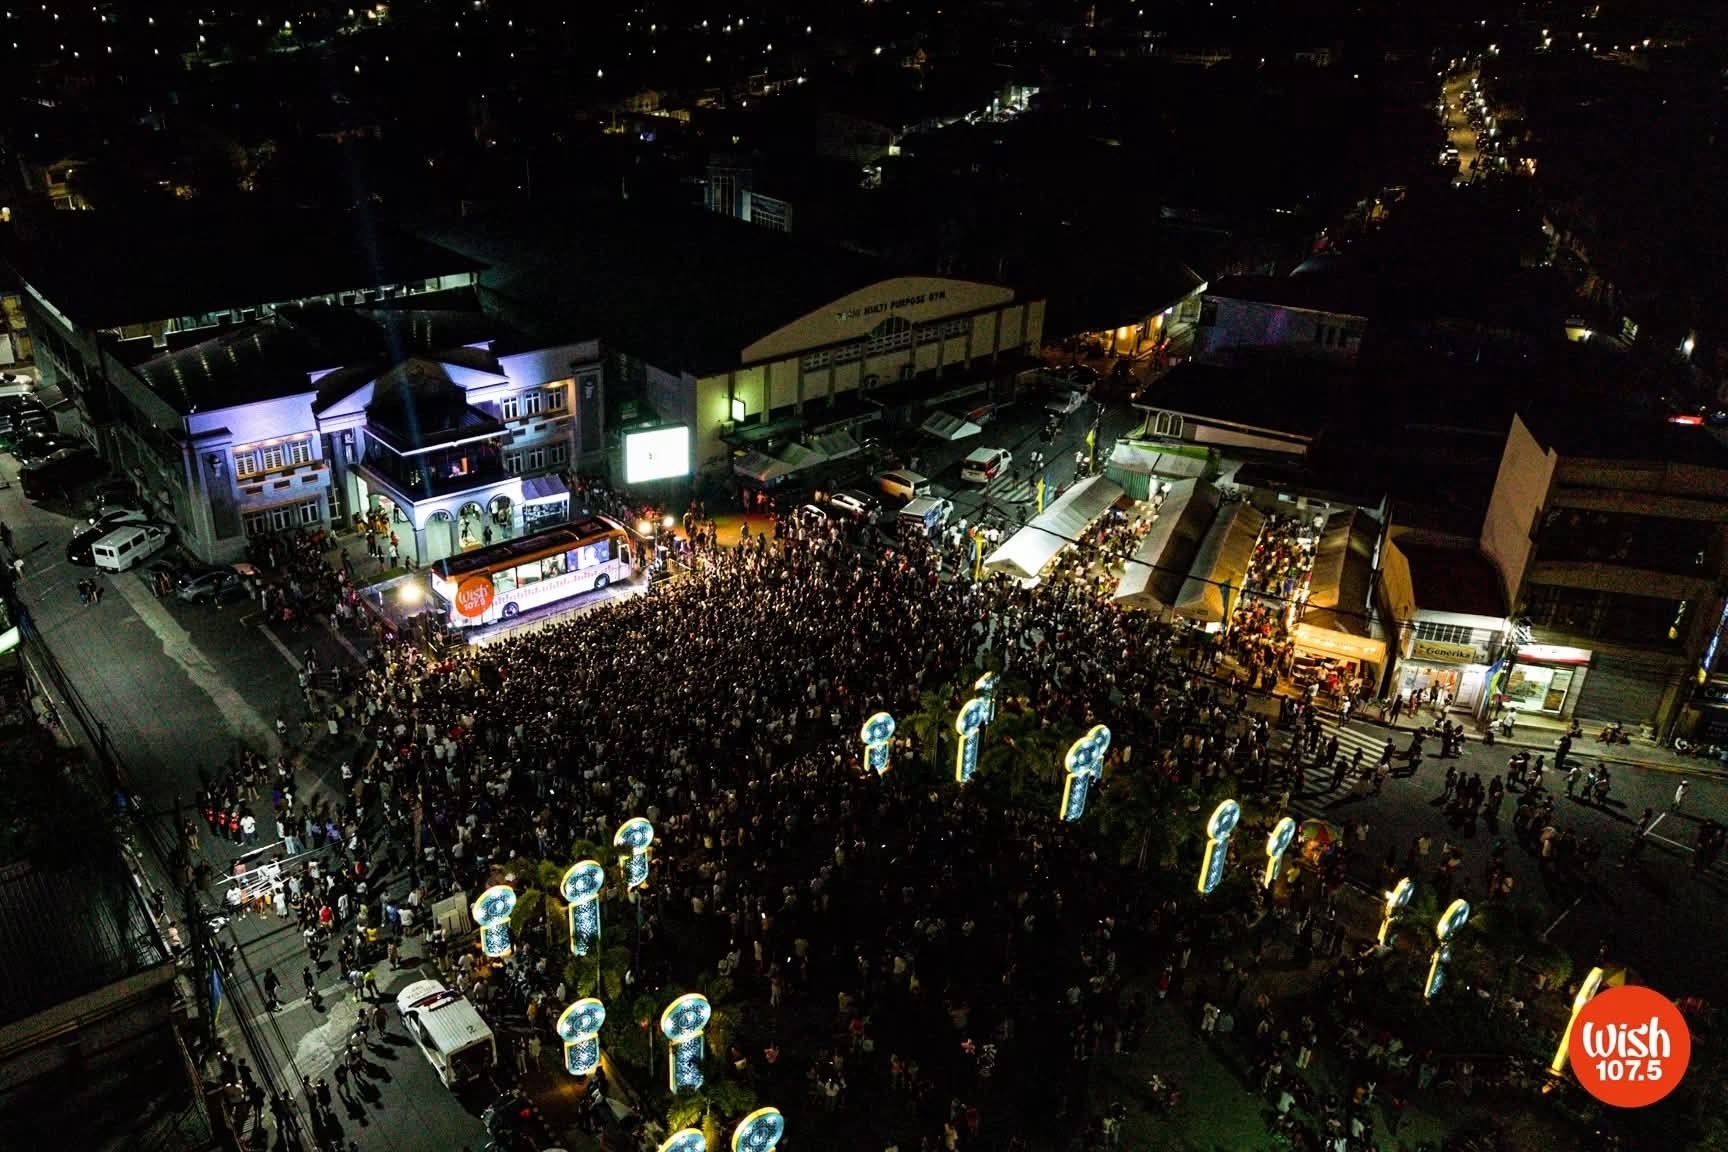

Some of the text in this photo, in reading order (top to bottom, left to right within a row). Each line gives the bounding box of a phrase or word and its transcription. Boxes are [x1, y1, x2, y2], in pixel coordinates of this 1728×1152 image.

[864, 303, 887, 314] MULTI
[890, 295, 925, 309] PURPOSE
[1425, 646, 1471, 659] Generika
